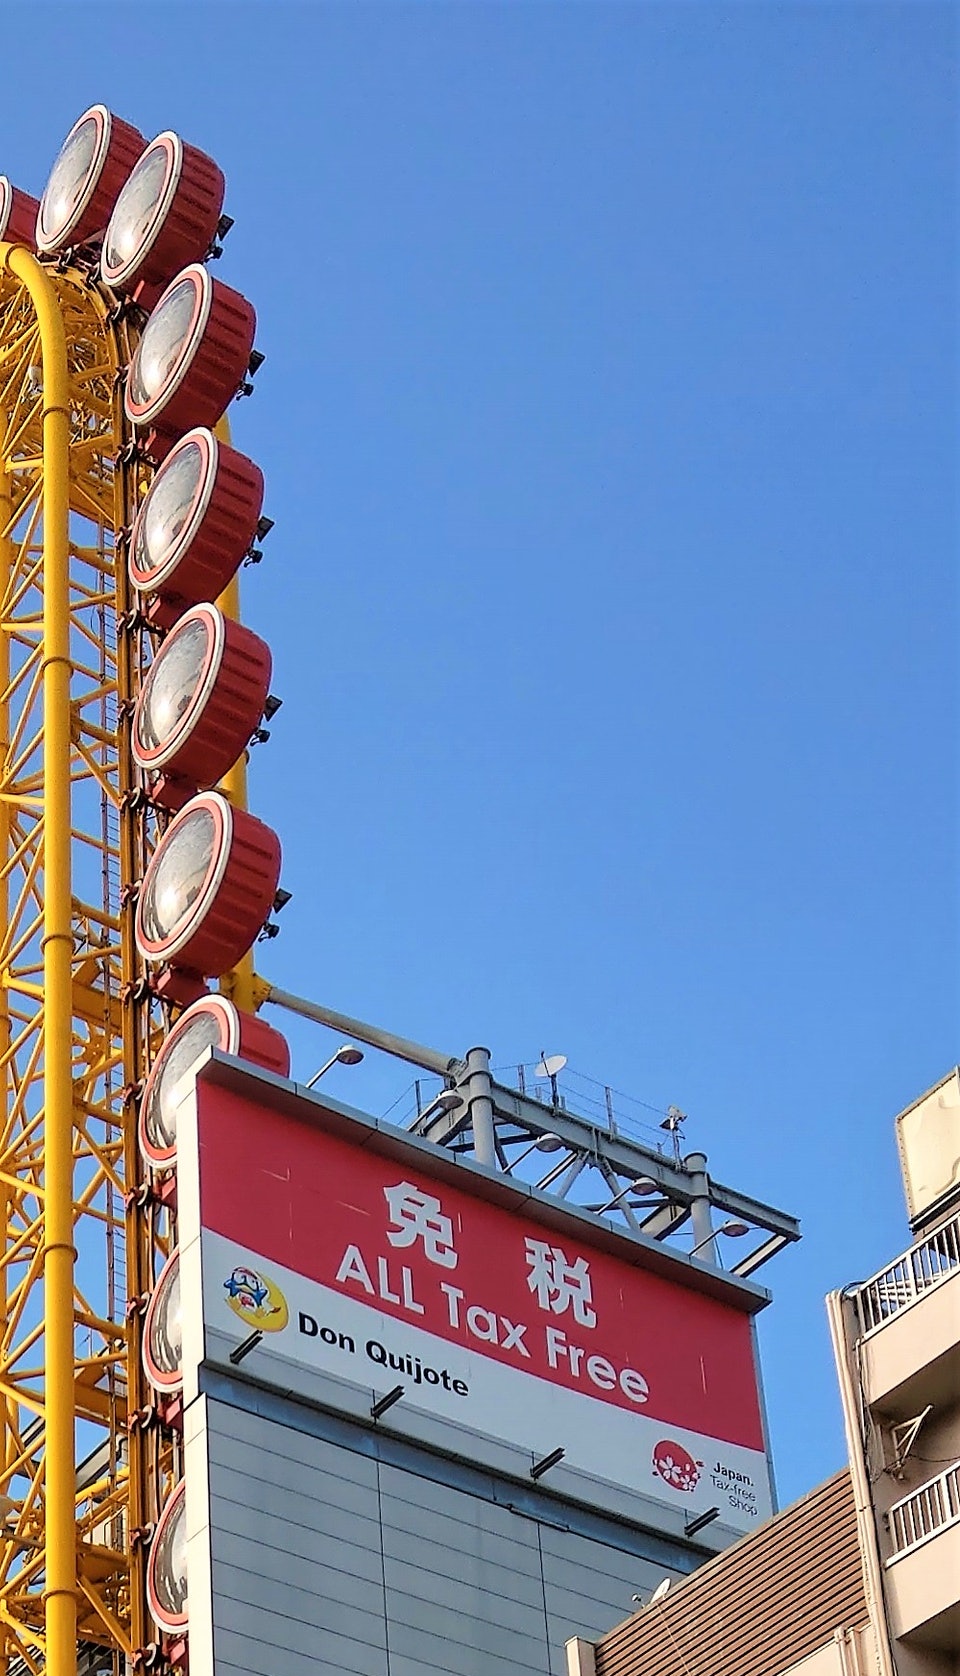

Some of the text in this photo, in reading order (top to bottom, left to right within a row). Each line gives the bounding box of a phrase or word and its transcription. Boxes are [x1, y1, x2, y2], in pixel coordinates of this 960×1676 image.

[383, 1180, 597, 1328] 免税
[298, 1311, 469, 1398] Don Quijote
[335, 1244, 650, 1404] ALL Tax Free
[709, 1474, 756, 1502] Tax-free
[728, 1495, 758, 1517] Shop
